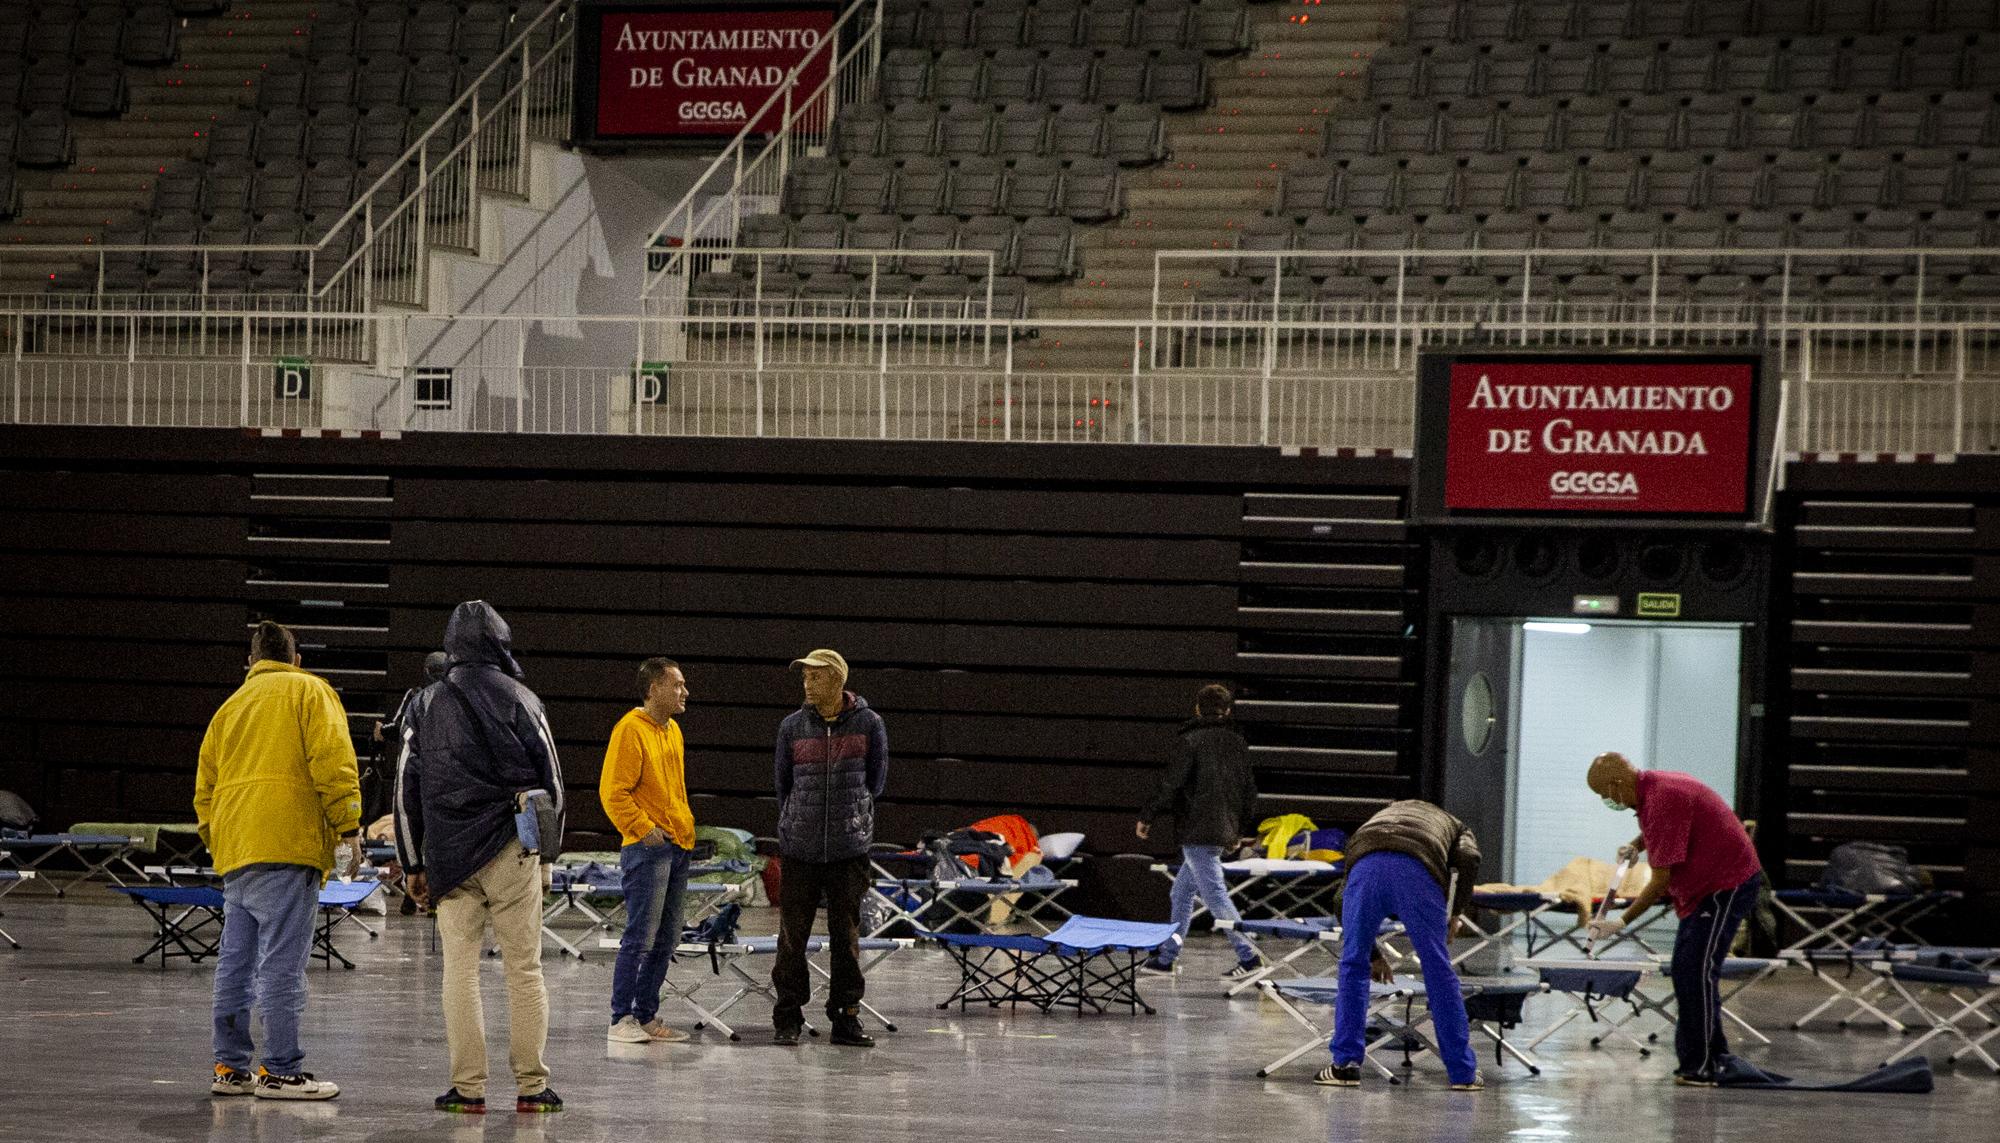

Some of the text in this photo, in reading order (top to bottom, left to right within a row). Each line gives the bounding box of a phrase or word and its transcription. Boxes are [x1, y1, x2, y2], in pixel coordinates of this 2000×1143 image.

[615, 22, 819, 51] AYUNTAMIENTO
[629, 66, 663, 87] DE
[283, 370, 303, 397] D
[1468, 374, 1734, 411] AYUNTAMIENTO
[1487, 418, 1708, 455] DE GRANADA
[1643, 599, 1675, 610] SALIDA
